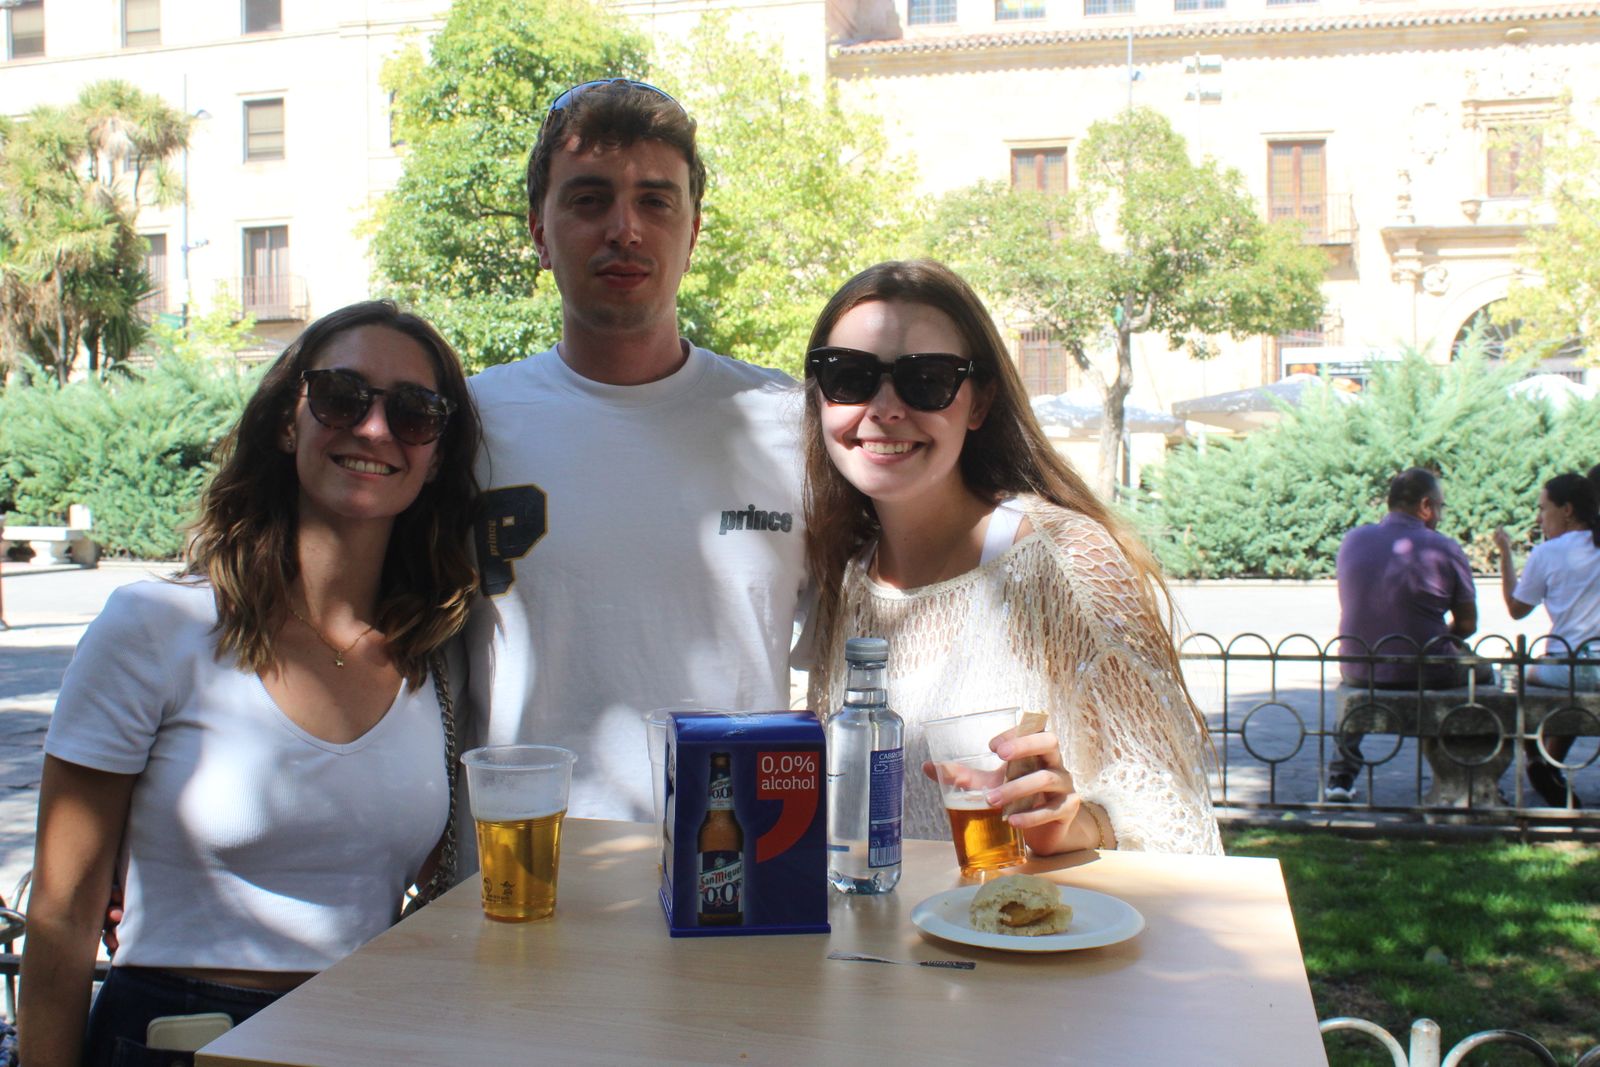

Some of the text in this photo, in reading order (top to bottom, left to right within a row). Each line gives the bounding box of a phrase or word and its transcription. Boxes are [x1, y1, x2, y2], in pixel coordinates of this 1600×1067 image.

[719, 504, 793, 535] prince
[761, 755, 816, 775] 0,0%
[761, 775, 816, 790] alcohol
